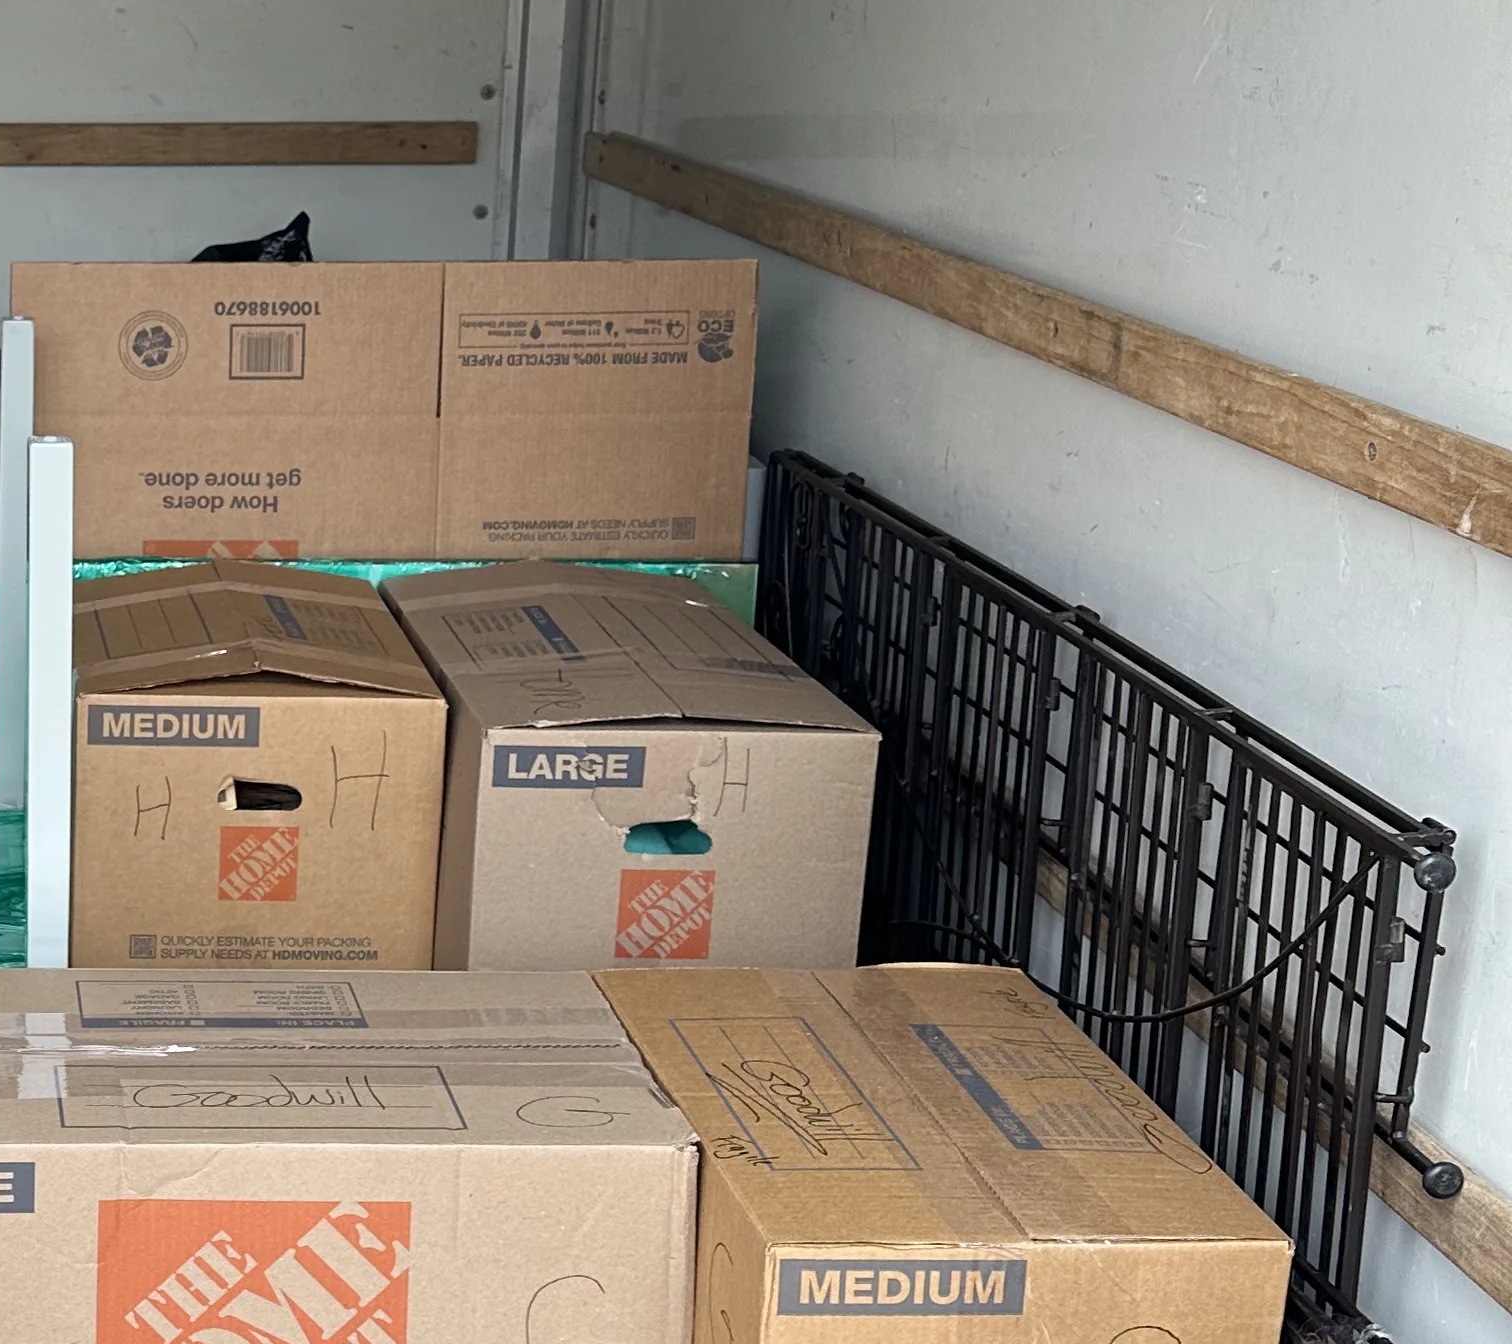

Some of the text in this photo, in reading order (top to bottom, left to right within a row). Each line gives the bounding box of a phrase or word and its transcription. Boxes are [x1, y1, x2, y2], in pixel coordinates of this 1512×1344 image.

[214, 301, 321, 316] 1006188670
[697, 318, 735, 334] ECO
[459, 351, 688, 367] MADE FROM 100% RECYCLED PAPER.
[204, 472, 261, 487] more
[266, 468, 302, 490] get
[162, 495, 279, 513] How doers
[488, 530, 669, 542] QUICKLY ESTIMATE YOUR PACKING
[573, 520, 589, 529] AT
[590, 519, 624, 529] NEEDS
[625, 518, 670, 529] SUPPLY
[102, 712, 246, 740] MEDIUM
[330, 729, 390, 831] H
[508, 753, 629, 781] LARGE
[713, 736, 750, 816] H
[134, 775, 172, 840] H
[227, 834, 263, 864] THE
[218, 827, 300, 900] HOME
[249, 855, 298, 902] DEPOT
[628, 879, 669, 915] THE
[616, 870, 714, 957] HOME
[160, 936, 371, 948] QUICKLY ESTIMATE YOUR PACKING
[652, 905, 712, 959] DEPOT
[160, 948, 378, 961] SUPPLY NEEDS AT HDMOVING.COM
[133, 1073, 386, 1111] Goodwill
[516, 1095, 632, 1128] G
[799, 1270, 1007, 1304] MEDIUM
